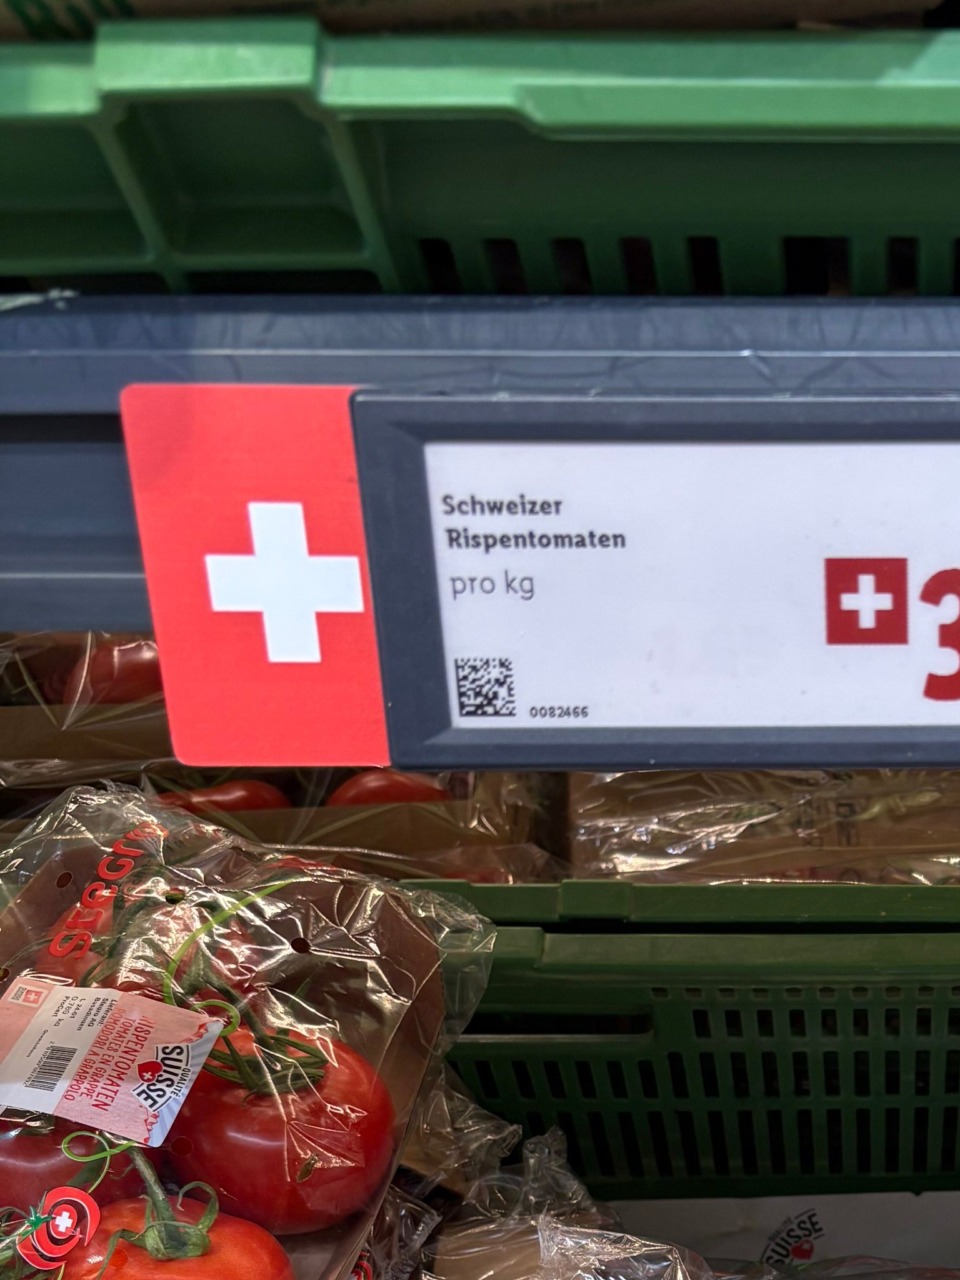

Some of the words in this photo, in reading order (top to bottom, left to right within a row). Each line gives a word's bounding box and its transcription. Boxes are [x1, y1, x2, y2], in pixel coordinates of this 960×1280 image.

[442, 494, 563, 516] Schweizer
[446, 528, 626, 555] Rispentomaten
[450, 576, 496, 601] pro
[504, 569, 535, 600] kg
[529, 706, 589, 719] 0082466
[93, 1008, 126, 1050] POMODORI
[107, 1017, 136, 1053] TOMATES
[88, 1049, 99, 1057] A
[99, 1053, 115, 1067] EN
[64, 1058, 96, 1101] GRAPPOLO
[80, 1066, 107, 1100] GRAPPE
[137, 1045, 184, 1109] SUISSE
[170, 1067, 192, 1097] QUALITÉ
[766, 1212, 823, 1264] SUISSE
